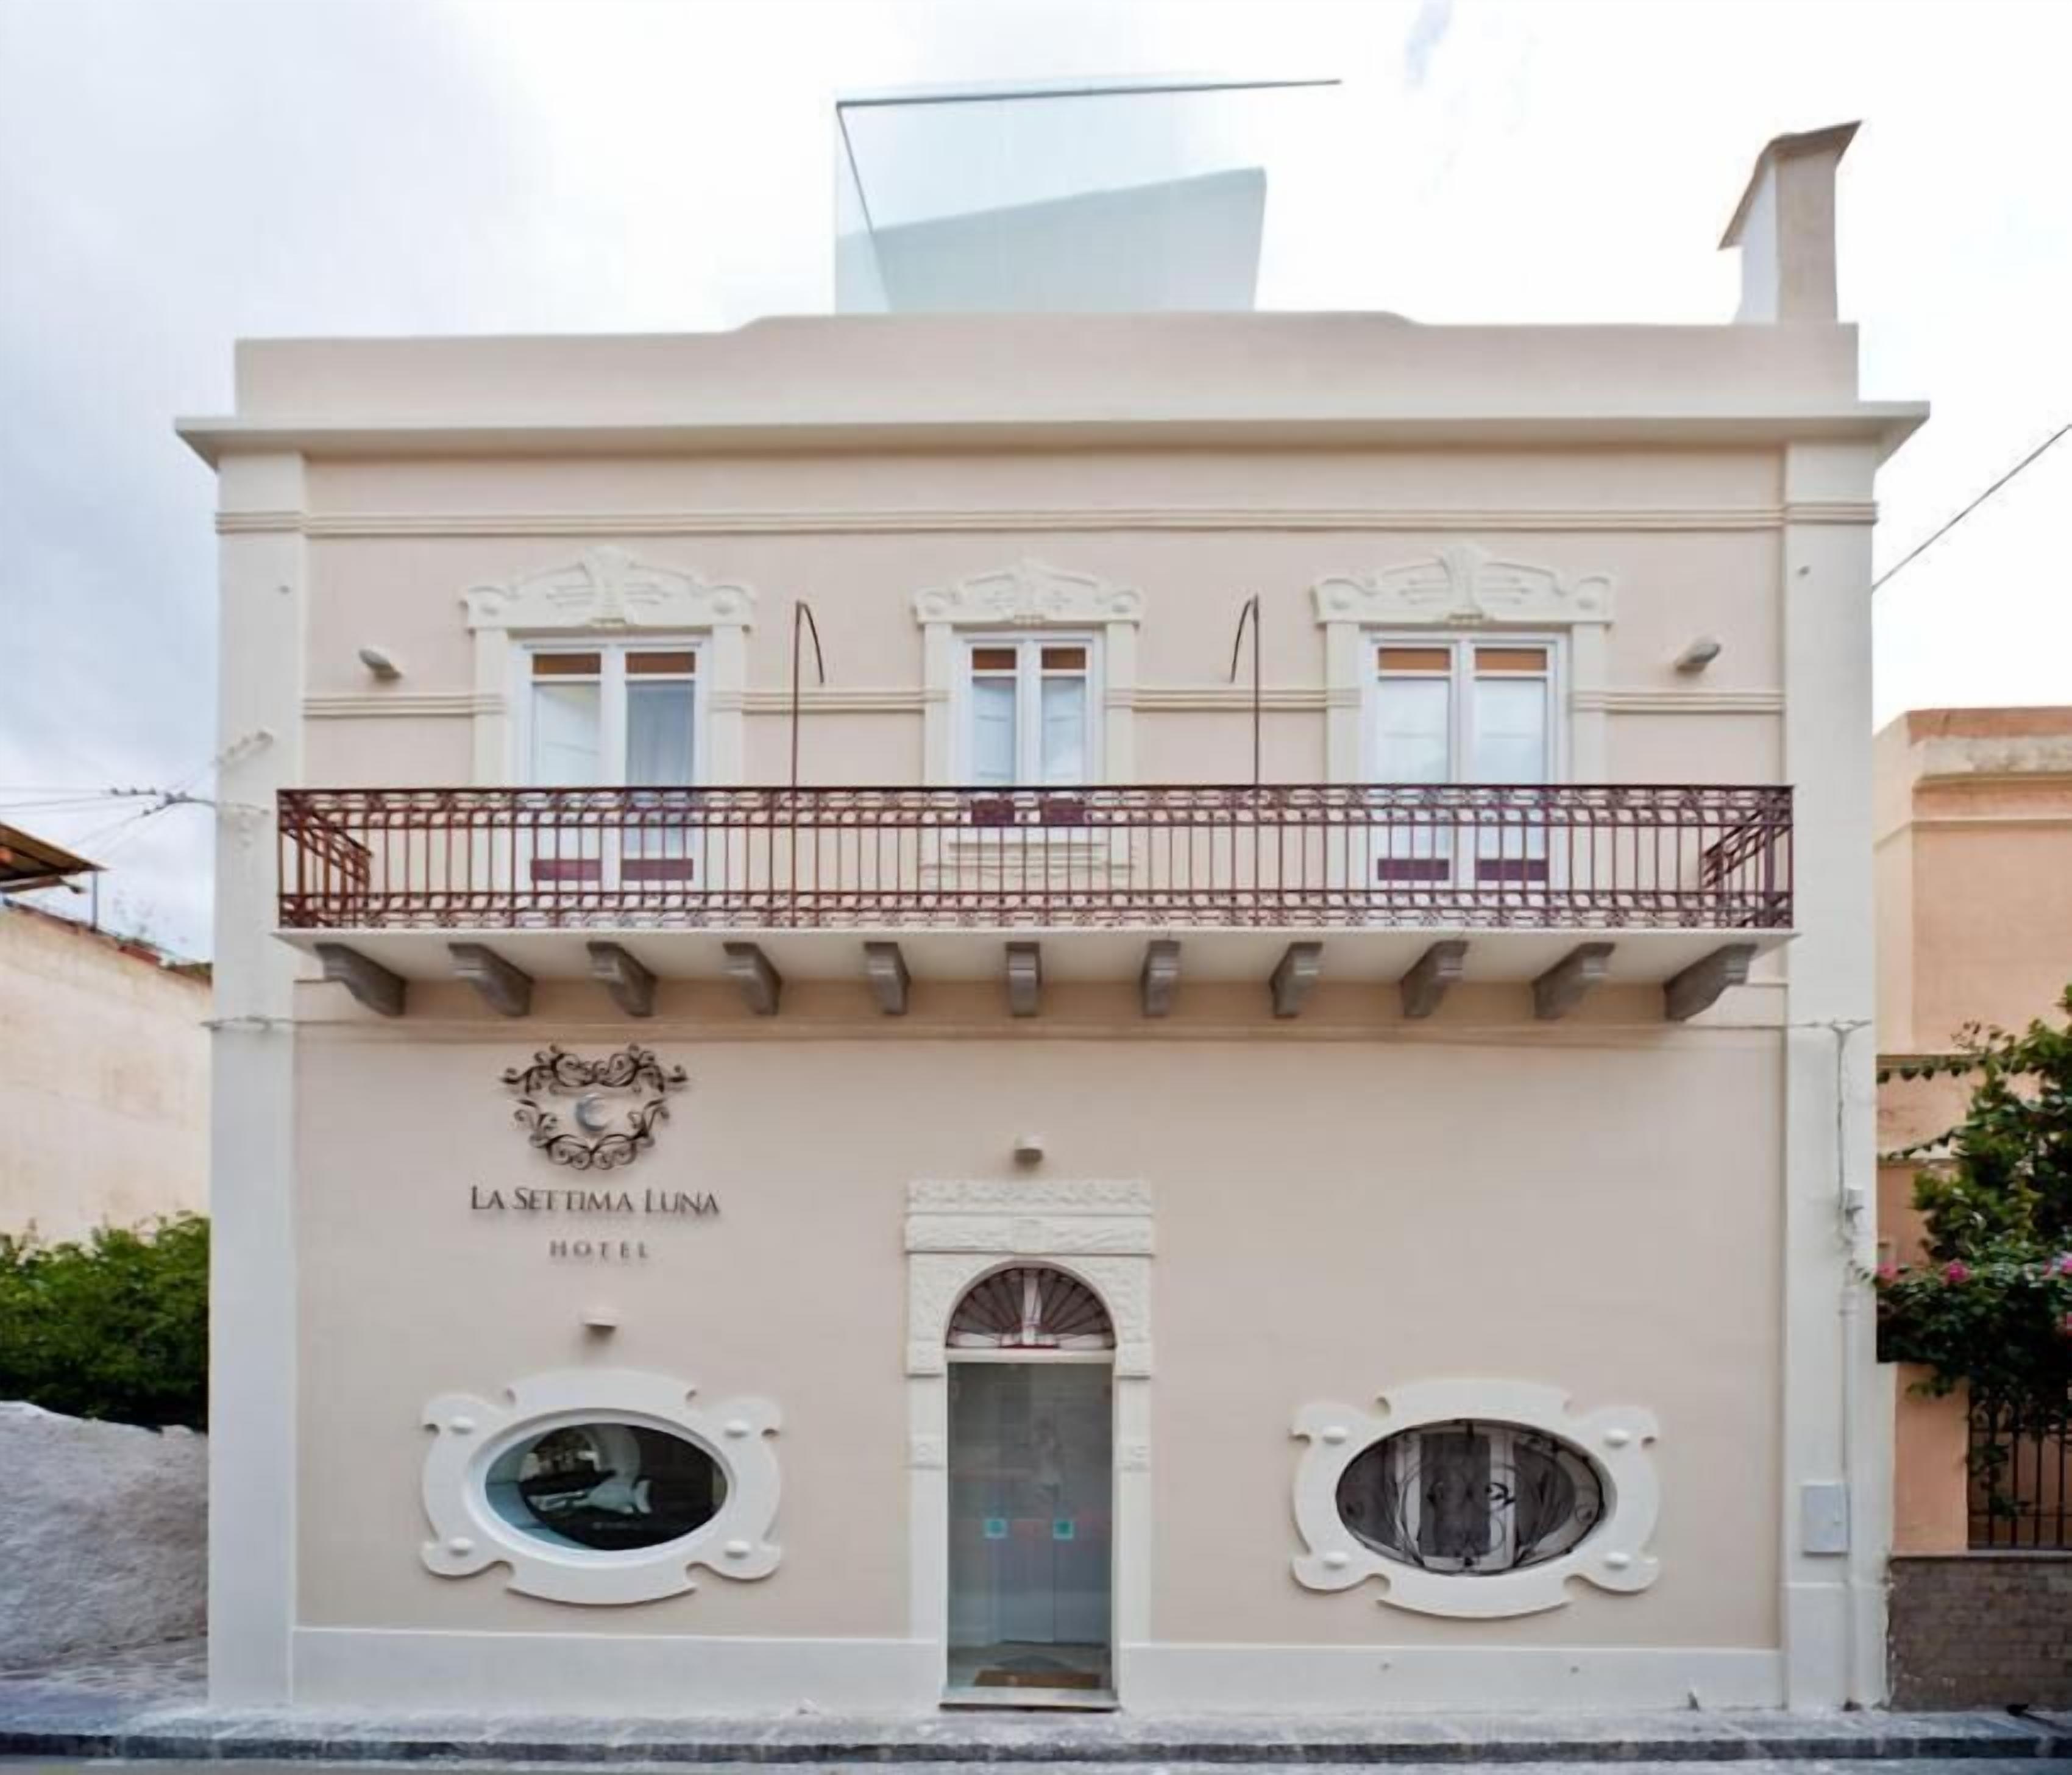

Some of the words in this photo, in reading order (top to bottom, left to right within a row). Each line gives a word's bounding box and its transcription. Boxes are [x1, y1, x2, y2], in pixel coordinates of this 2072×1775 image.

[471, 1186, 505, 1210] LA
[513, 1187, 633, 1212] SETTIMA
[644, 1189, 720, 1215] LUNA
[550, 1240, 648, 1259] HOTEL
